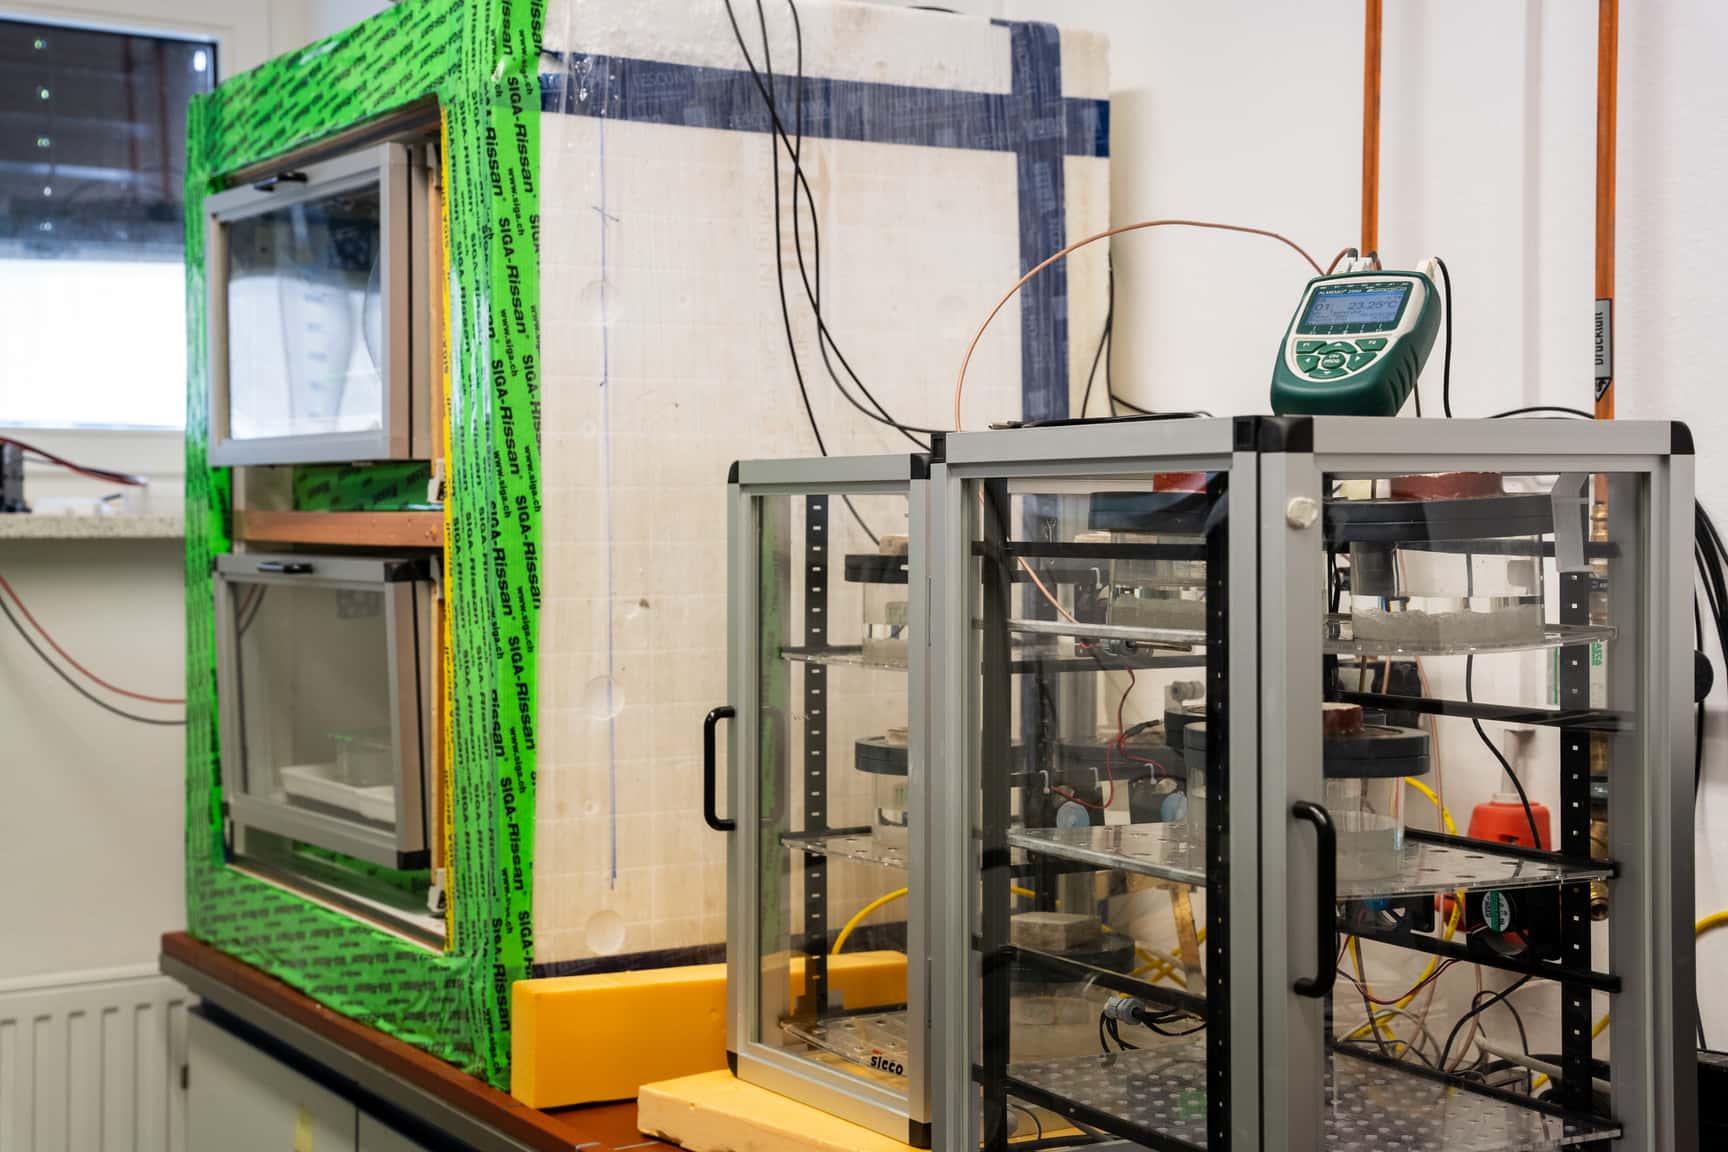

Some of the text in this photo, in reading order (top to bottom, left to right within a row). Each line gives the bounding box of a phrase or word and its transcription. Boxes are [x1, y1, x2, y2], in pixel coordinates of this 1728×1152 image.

[507, 76, 534, 193] SIGA-Rissan
[508, 167, 526, 236] www.siga.ch
[499, 217, 526, 334] SIGA-Rissan
[501, 309, 519, 377] www.siga.ch
[492, 359, 520, 475] SIGA-Rissan
[494, 450, 511, 518] www.siga.ch
[516, 495, 542, 609] SIGA-Rissan
[517, 586, 534, 653] www.siga.ch
[509, 636, 535, 750] SIGA-Rissan
[501, 777, 524, 891] SIGA-Rissan
[870, 1056, 903, 1075] sicco
